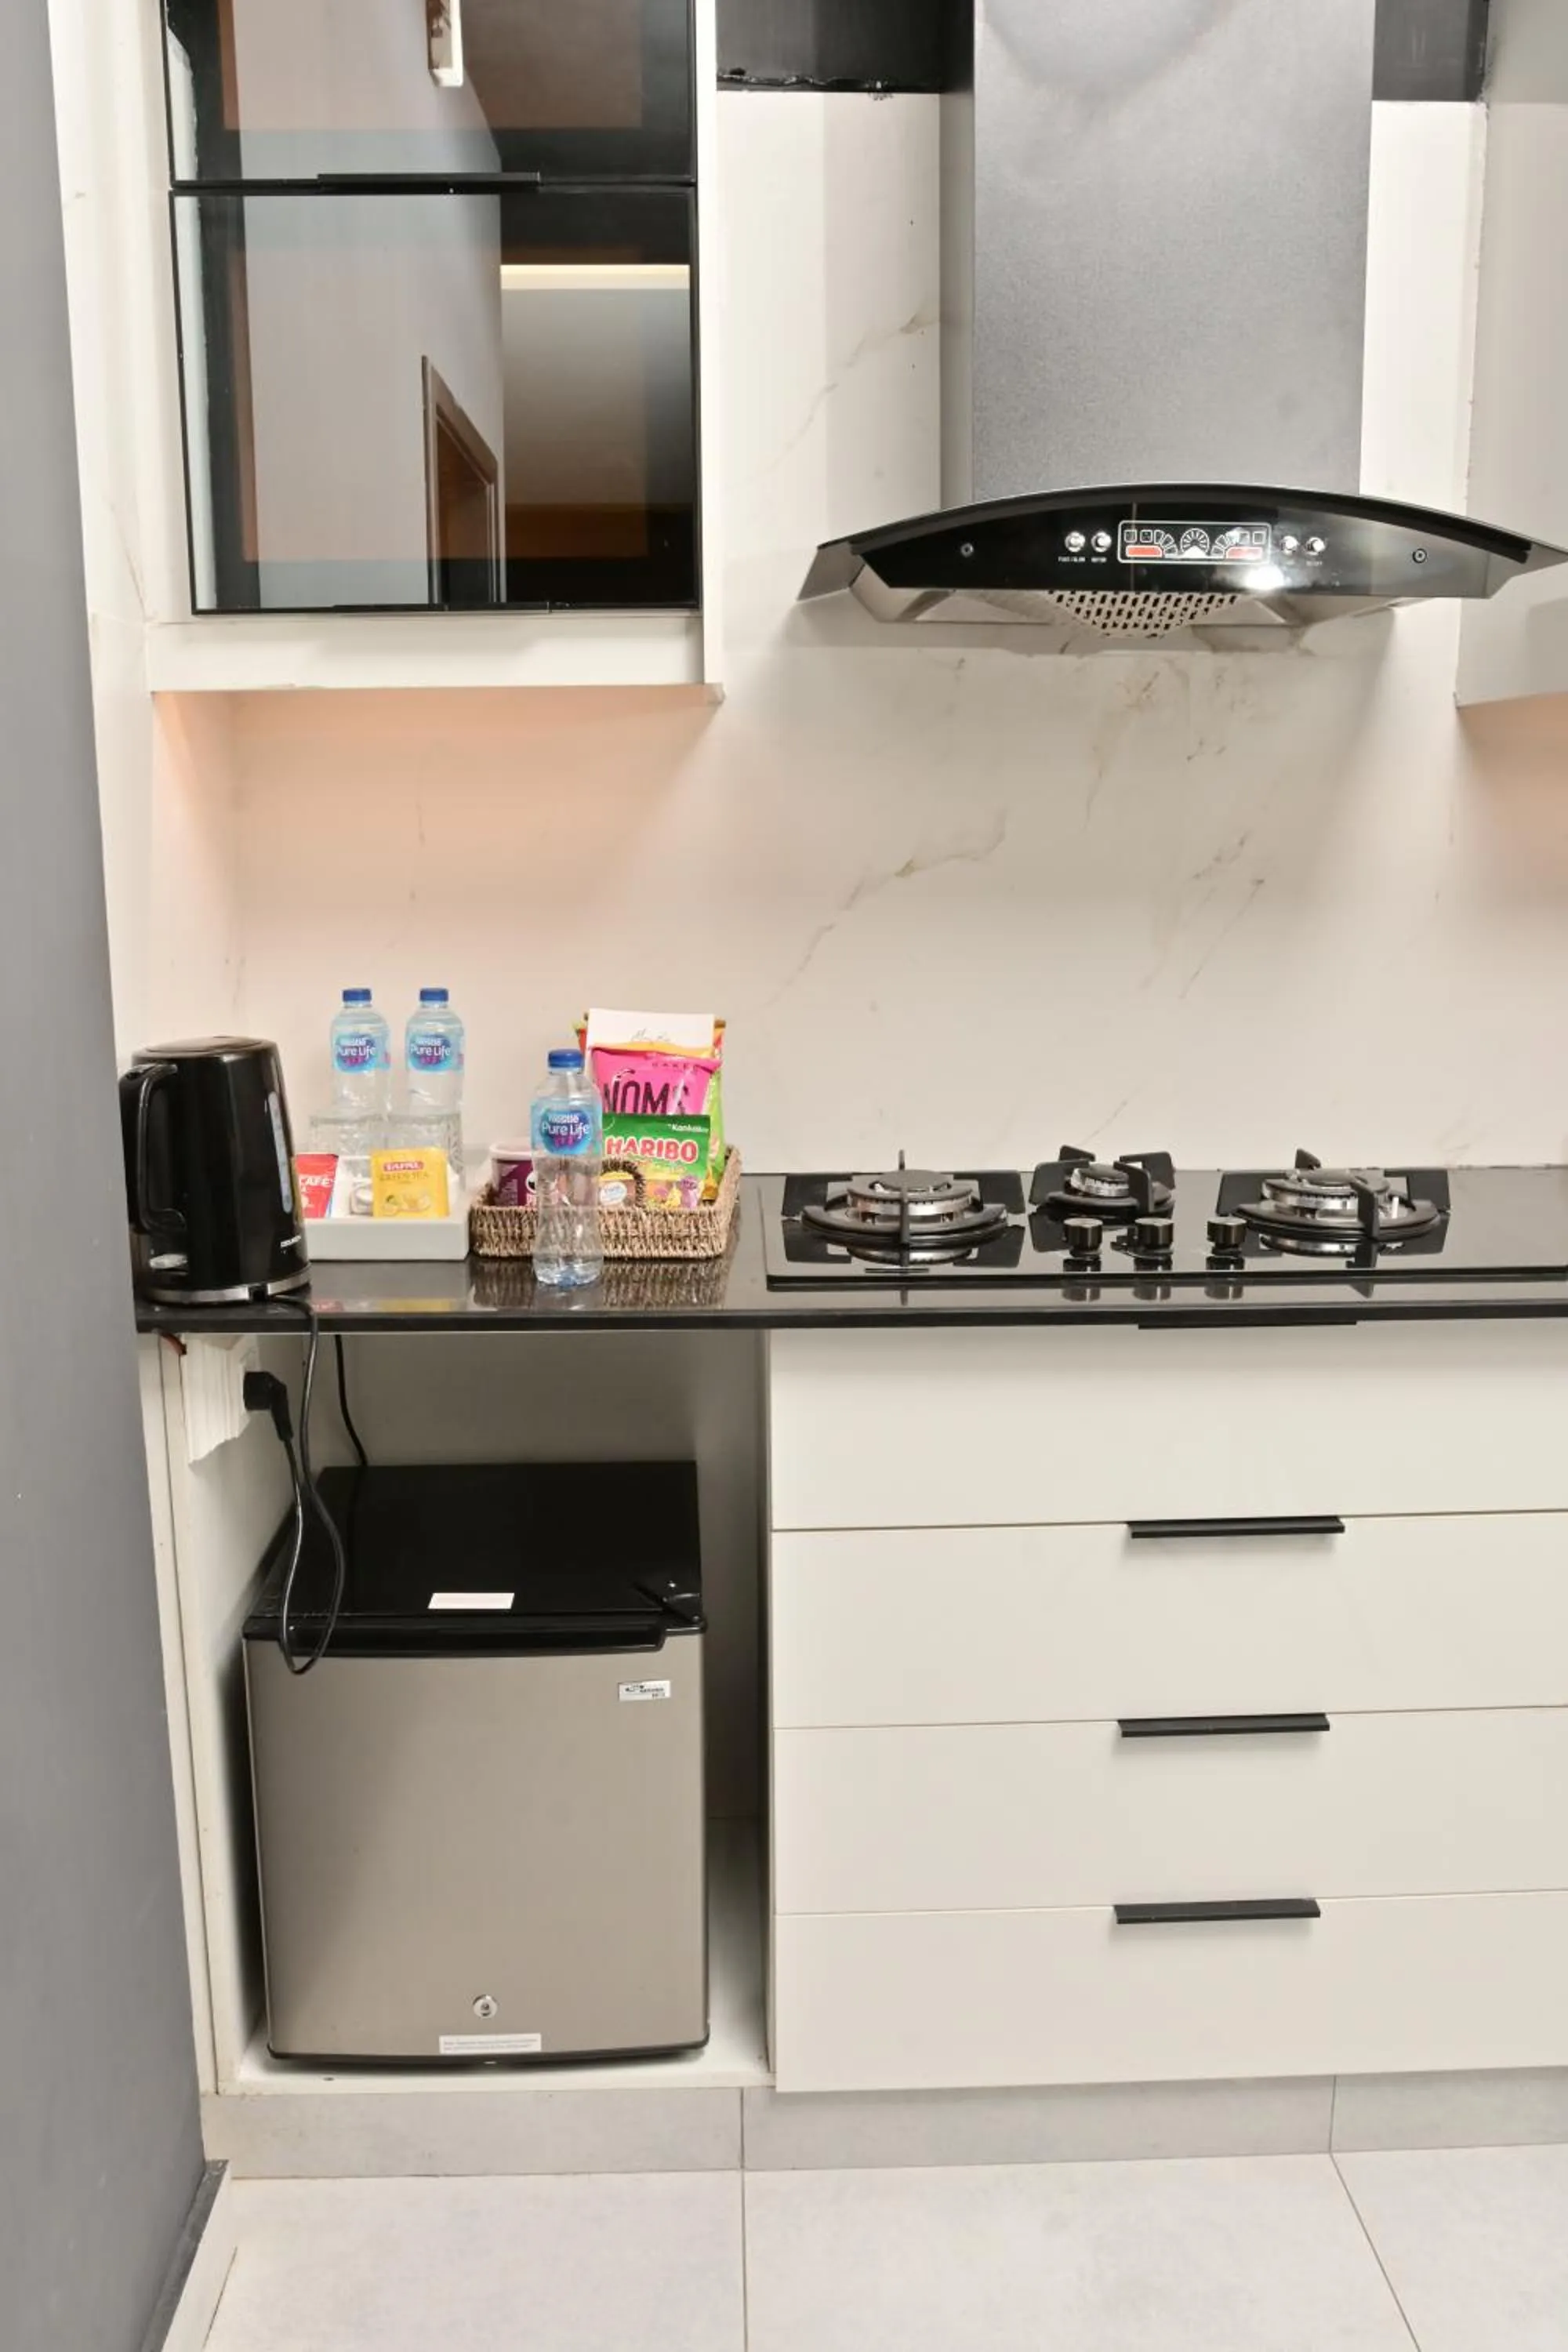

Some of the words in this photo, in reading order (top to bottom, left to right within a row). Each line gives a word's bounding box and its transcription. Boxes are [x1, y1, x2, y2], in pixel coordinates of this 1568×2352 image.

[411, 1044, 432, 1056] Pure
[434, 1045, 452, 1059] Life
[542, 1121, 568, 1136] Pure
[570, 1121, 590, 1139] Life
[605, 1136, 699, 1163] HARIBO
